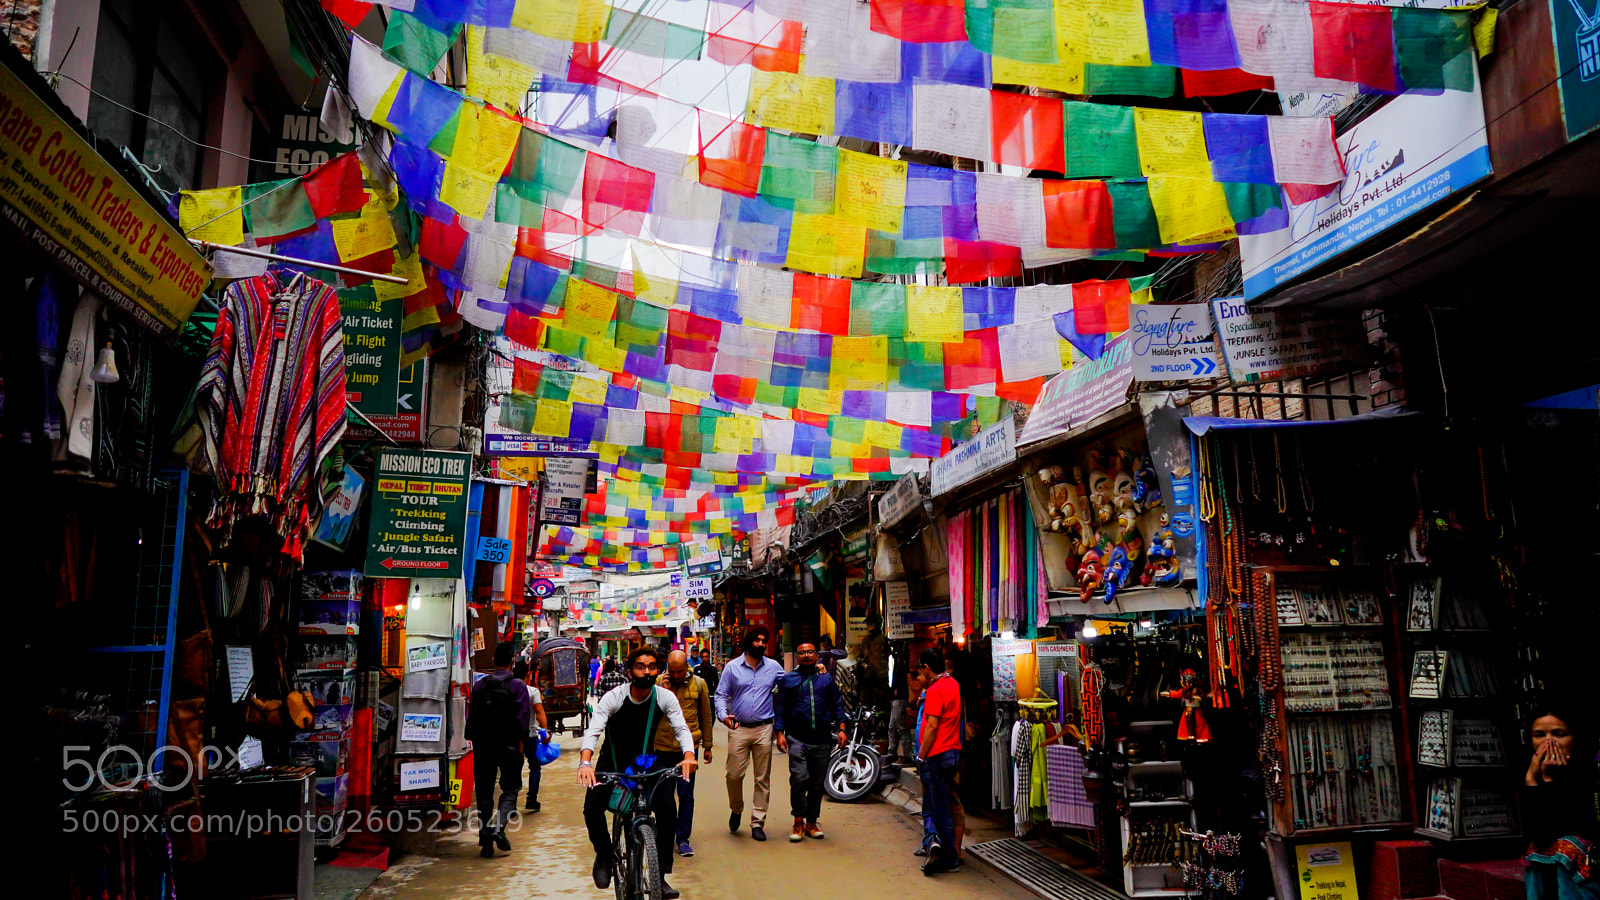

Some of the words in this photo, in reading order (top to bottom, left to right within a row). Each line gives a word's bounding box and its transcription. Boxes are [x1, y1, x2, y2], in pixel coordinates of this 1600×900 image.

[1395, 170, 1451, 208] 01-4412928
[1317, 201, 1360, 232] Holidays
[1361, 187, 1383, 206] Pvt.
[1385, 172, 1407, 193] Ltd.
[38, 130, 95, 202] Cotton
[90, 175, 144, 246] Traders
[138, 223, 158, 256] &
[149, 232, 205, 299] Exporters
[61, 200, 112, 248] Wholesaler
[32, 229, 60, 254] POST
[57, 248, 95, 281] PARCEL
[99, 280, 135, 313] COURIER
[133, 304, 166, 334] SERVICE
[361, 316, 393, 329] Ticket
[1132, 307, 1198, 357] Signature
[356, 334, 386, 349] Flight
[1151, 347, 1182, 357] Holidays
[1183, 346, 1198, 355] Pvt.
[1200, 345, 1216, 354] Ltd.
[1150, 364, 1165, 373] 2ND
[1166, 363, 1192, 372] FLOOR
[351, 371, 379, 387] Jump
[954, 440, 981, 466] PASHMINA
[985, 426, 1006, 449] ARTS
[380, 454, 421, 472] MISSION
[422, 457, 440, 474] ECO
[442, 458, 465, 476] TREK
[380, 482, 404, 490] NEPAL
[408, 483, 430, 491] TIBET
[434, 484, 461, 493] BHUTAN
[400, 495, 439, 505] TOUR
[382, 532, 420, 542] Jungle
[422, 534, 454, 543] Safari
[377, 544, 421, 554] Air/Bus
[424, 545, 458, 555] Ticket
[484, 538, 509, 550] Sale
[482, 550, 504, 561] 350
[689, 580, 704, 588] SIM
[685, 588, 709, 597] CARD
[1038, 645, 1049, 653] 100%
[1050, 645, 1075, 653] CASHMERE
[411, 660, 423, 669] BABY
[418, 767, 437, 775] WOOL
